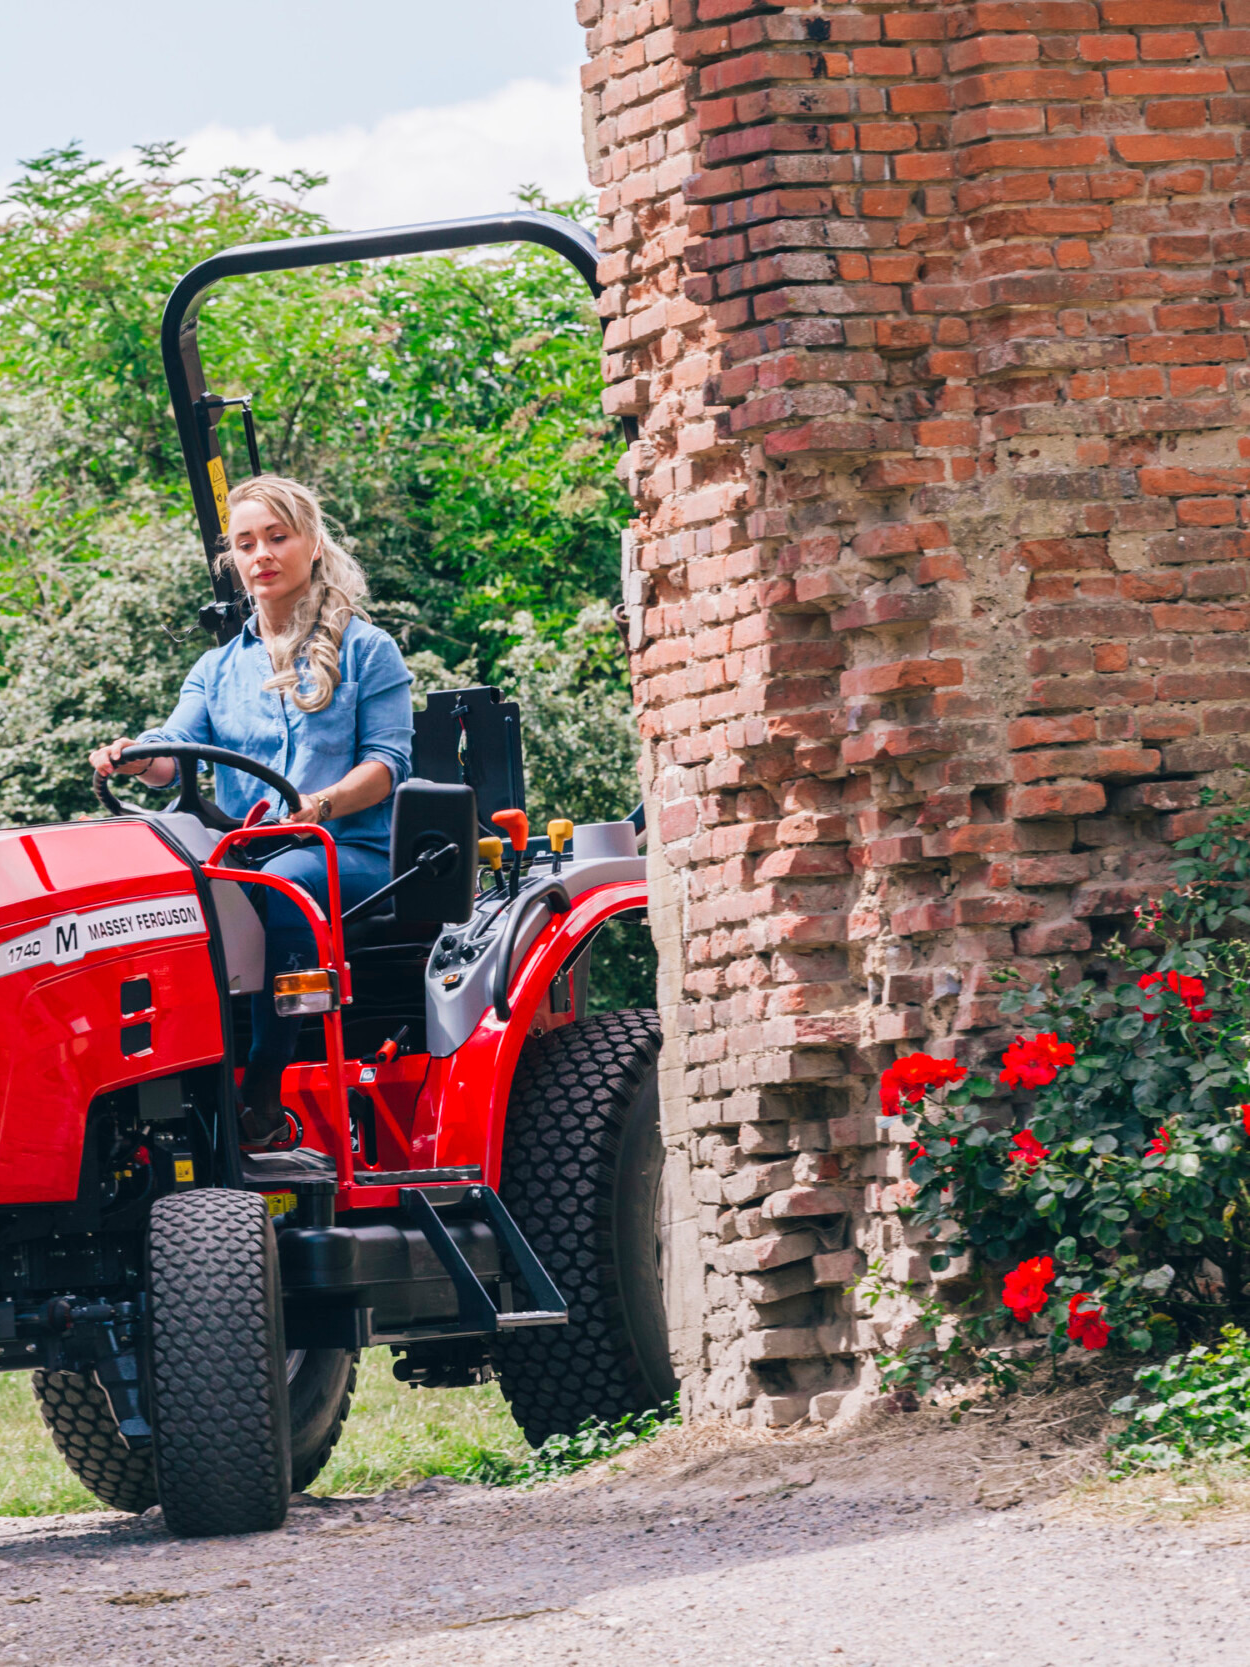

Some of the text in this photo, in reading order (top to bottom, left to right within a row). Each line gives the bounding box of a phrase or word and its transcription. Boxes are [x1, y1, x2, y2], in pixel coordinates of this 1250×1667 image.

[8, 906, 197, 963] 1740 M MASSEY FERGUSON
